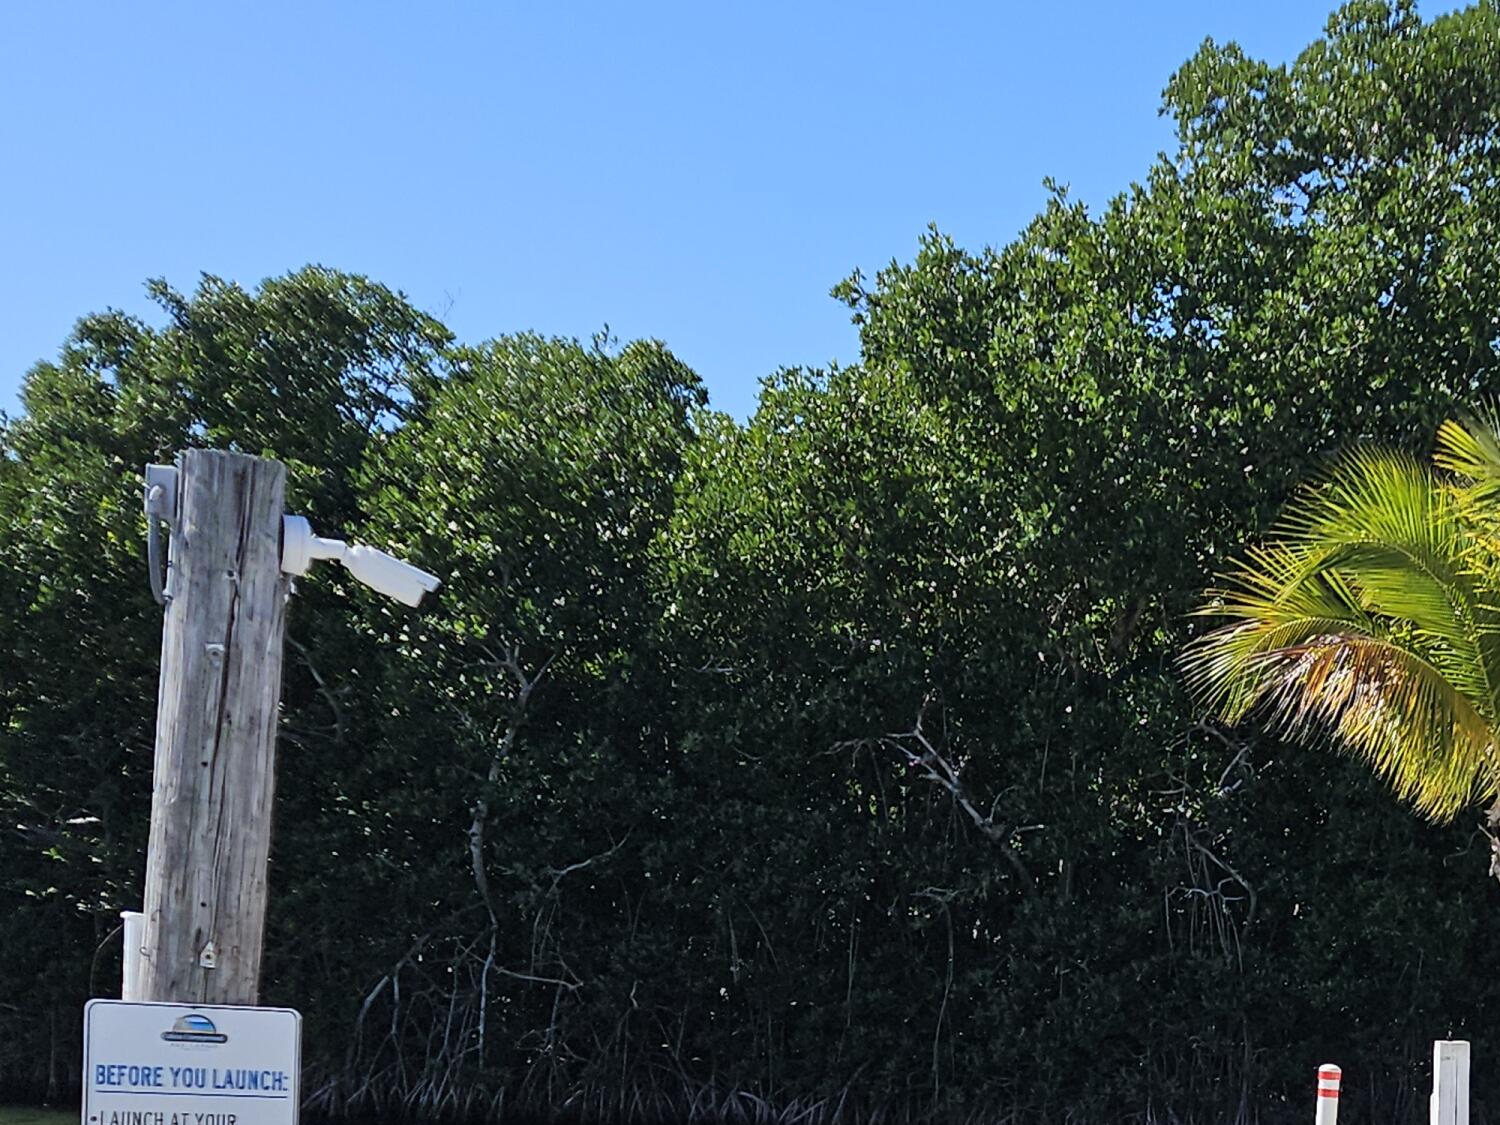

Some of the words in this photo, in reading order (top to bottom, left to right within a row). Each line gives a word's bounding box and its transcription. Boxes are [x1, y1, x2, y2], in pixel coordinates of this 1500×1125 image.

[96, 1064, 163, 1087] BEFORE
[170, 1067, 206, 1089] YOU
[213, 1069, 288, 1091] LAUNCH:
